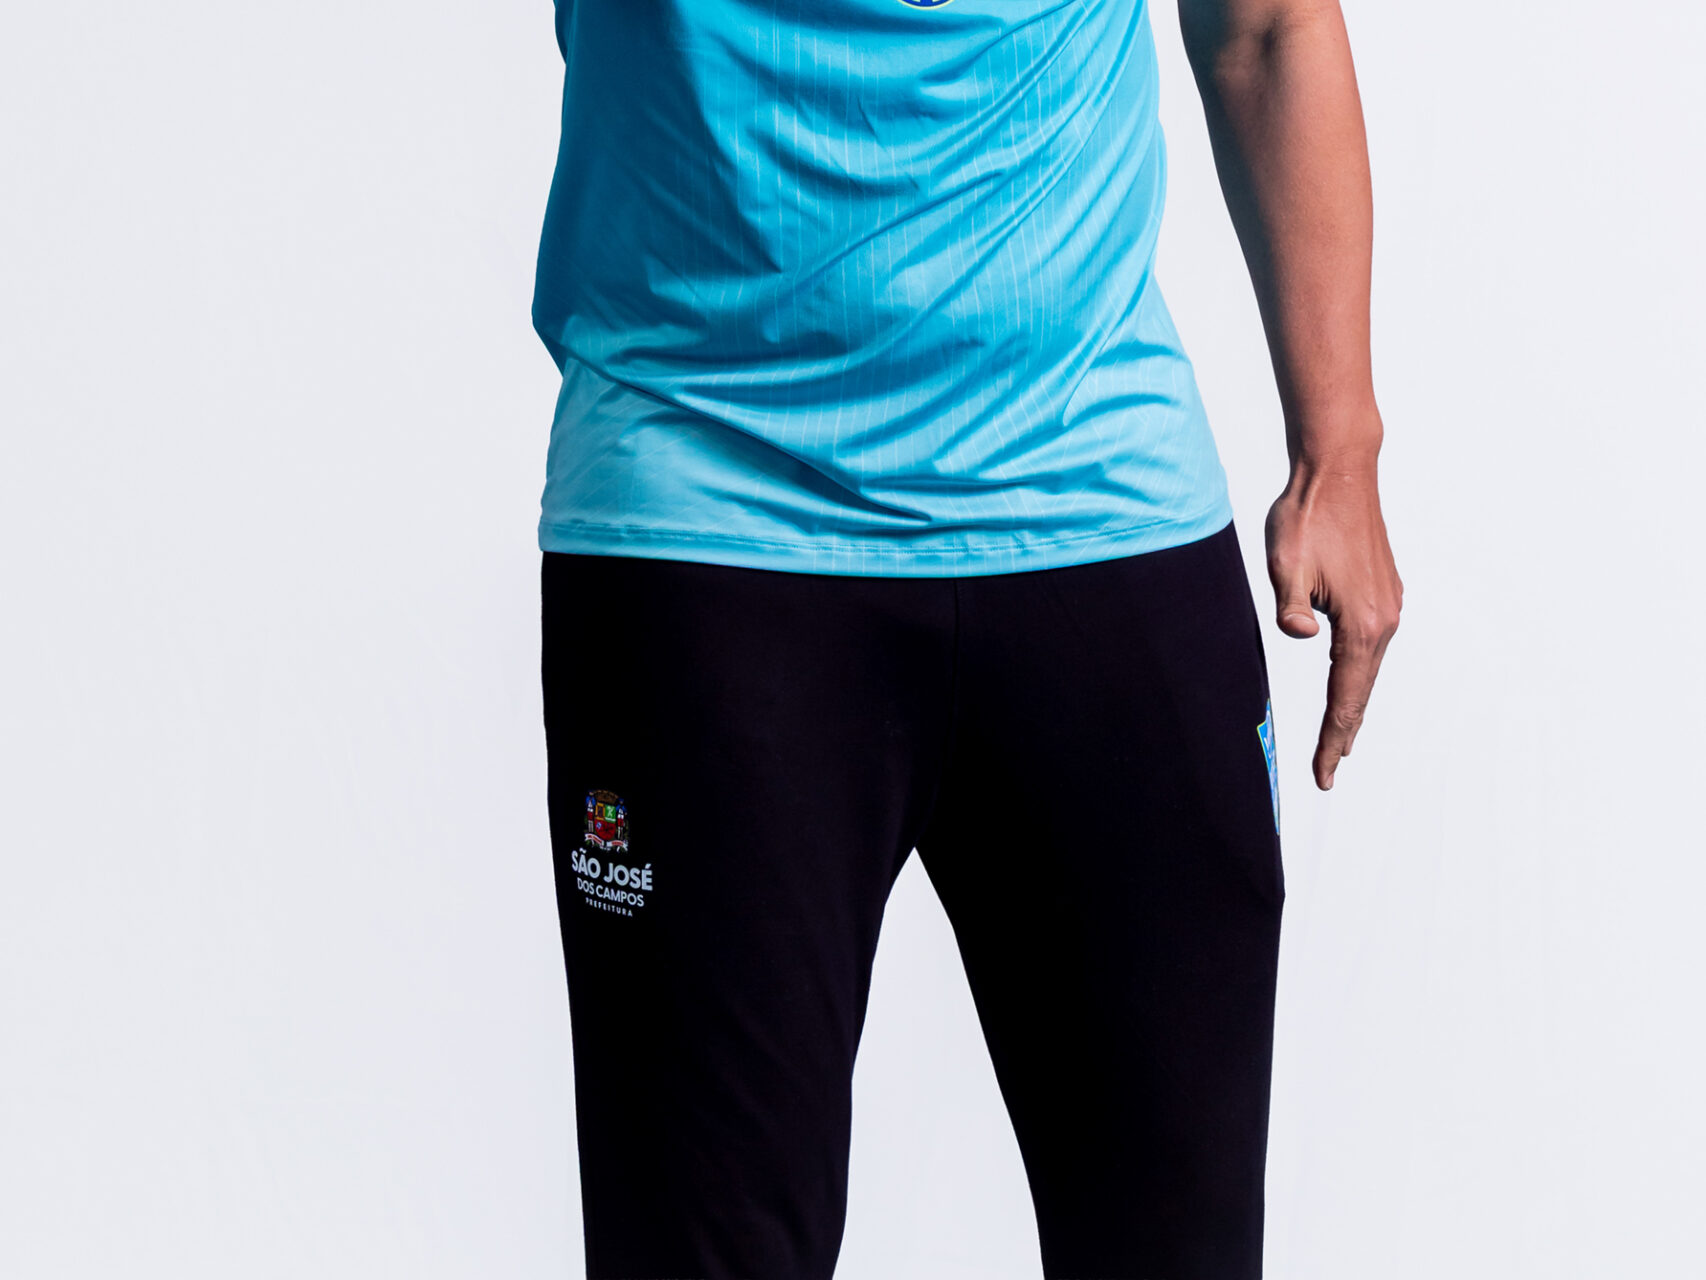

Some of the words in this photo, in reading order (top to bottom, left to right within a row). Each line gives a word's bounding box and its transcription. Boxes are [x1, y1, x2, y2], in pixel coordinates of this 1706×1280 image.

[571, 847, 601, 879] SÃO
[603, 863, 653, 891] JOSÉ
[577, 877, 594, 895] DOS
[596, 884, 645, 907] CAMPOS
[585, 897, 633, 917] PREFEITURA
